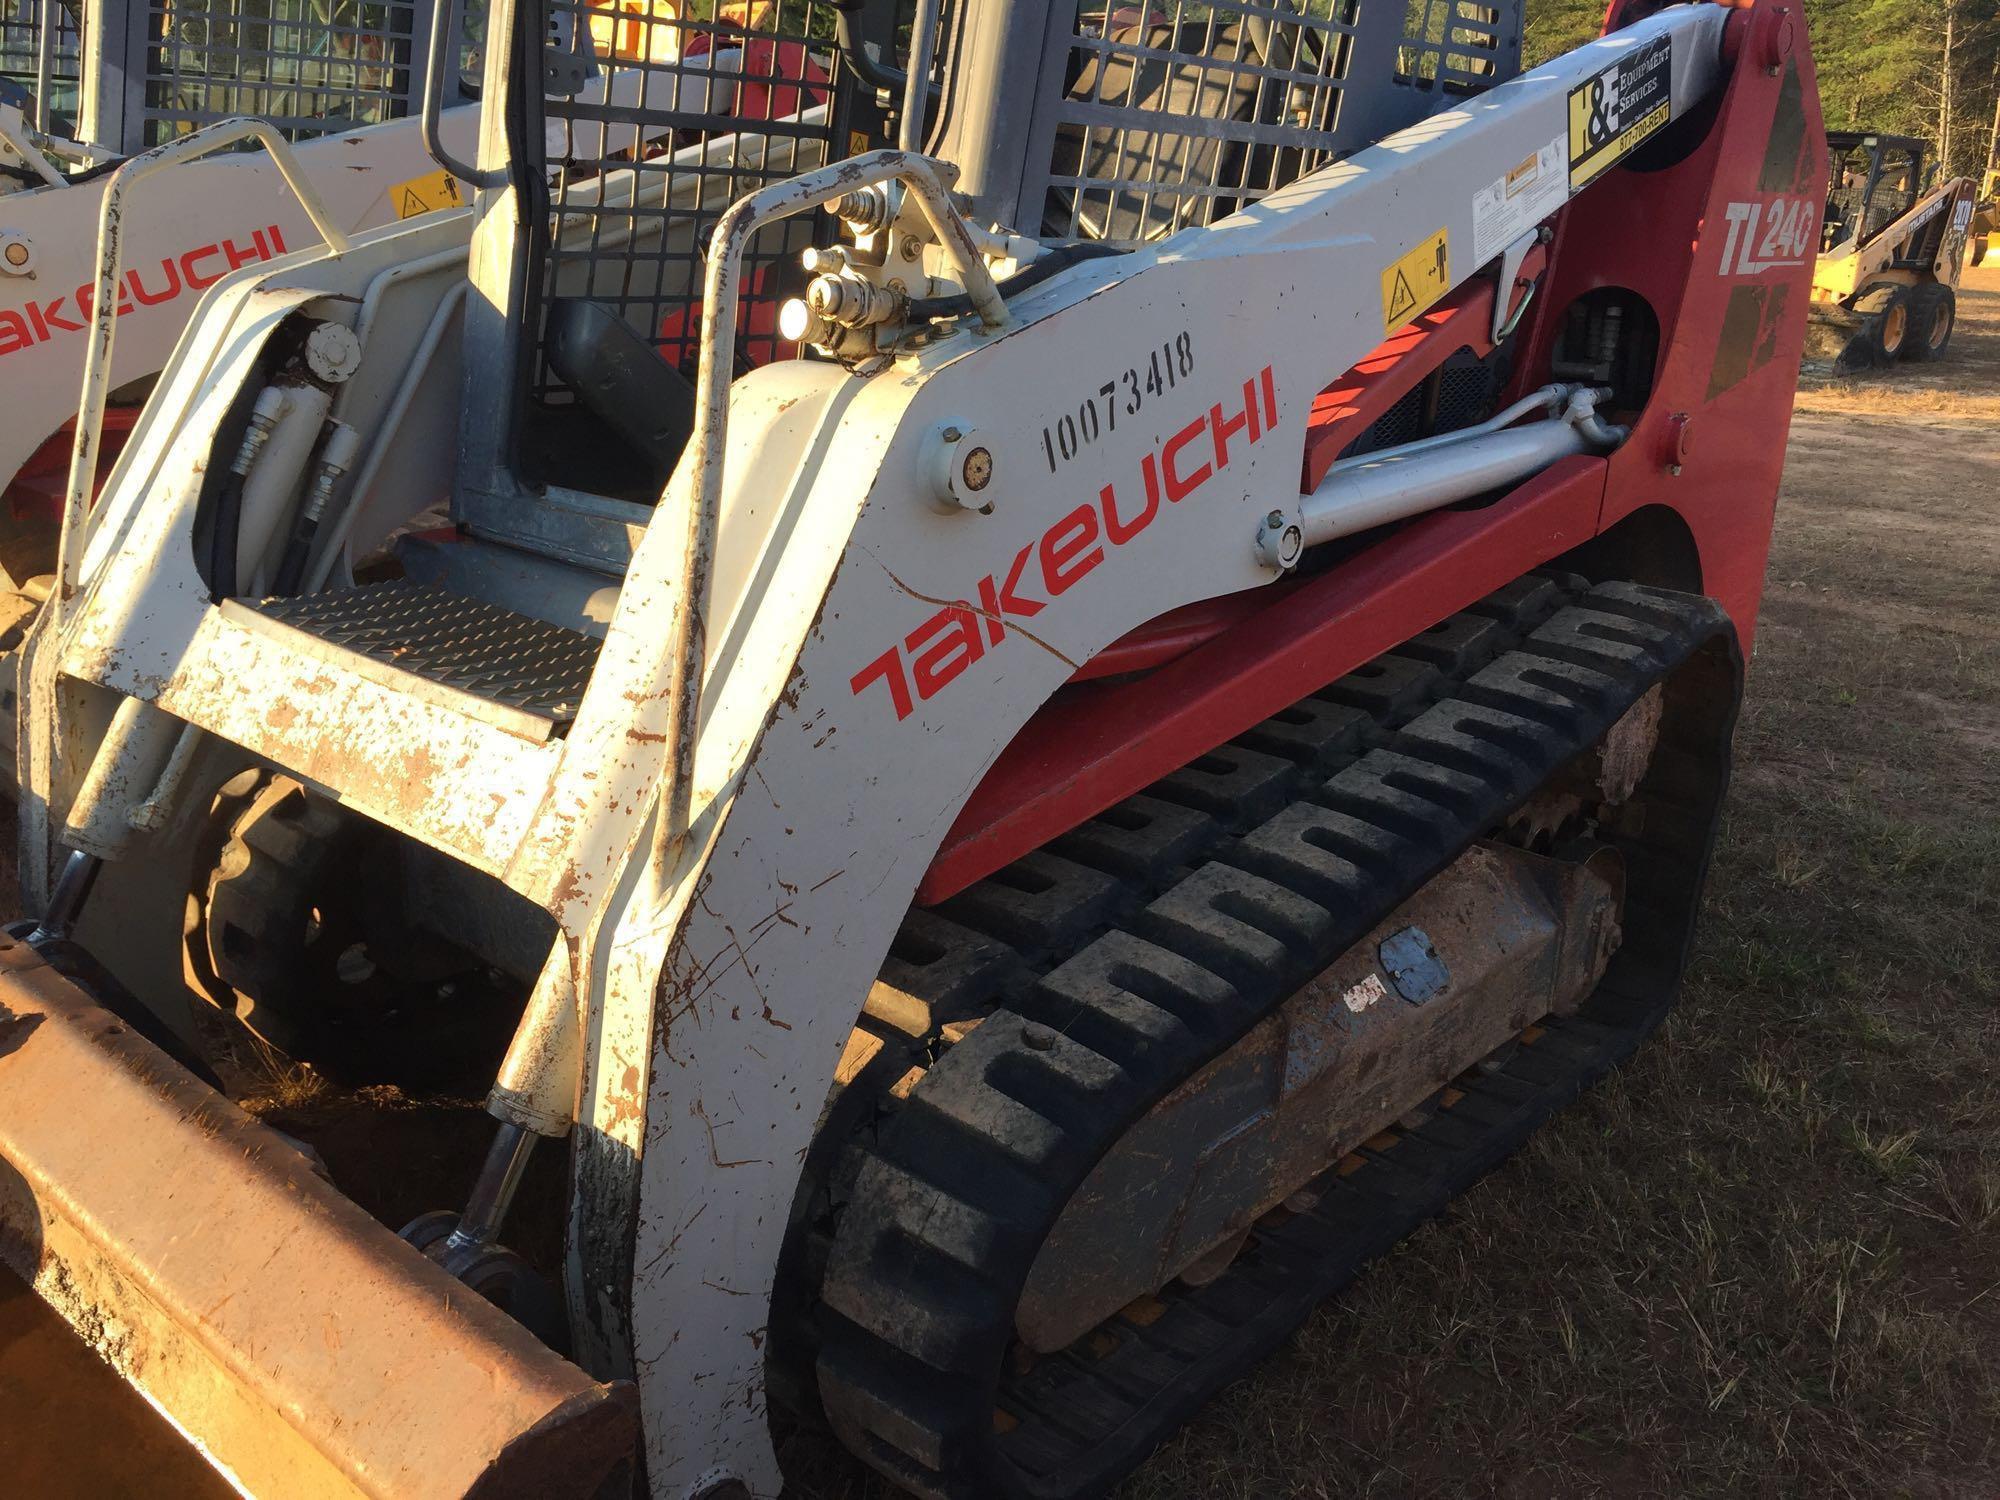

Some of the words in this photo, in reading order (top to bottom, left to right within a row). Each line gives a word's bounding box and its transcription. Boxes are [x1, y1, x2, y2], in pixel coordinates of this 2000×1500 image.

[1620, 46, 1670, 91] EQUIPMENT
[1619, 77, 1657, 113] SERVICES
[1620, 104, 1669, 151] 877-700-RENT
[1043, 331, 1193, 473] 10073418
